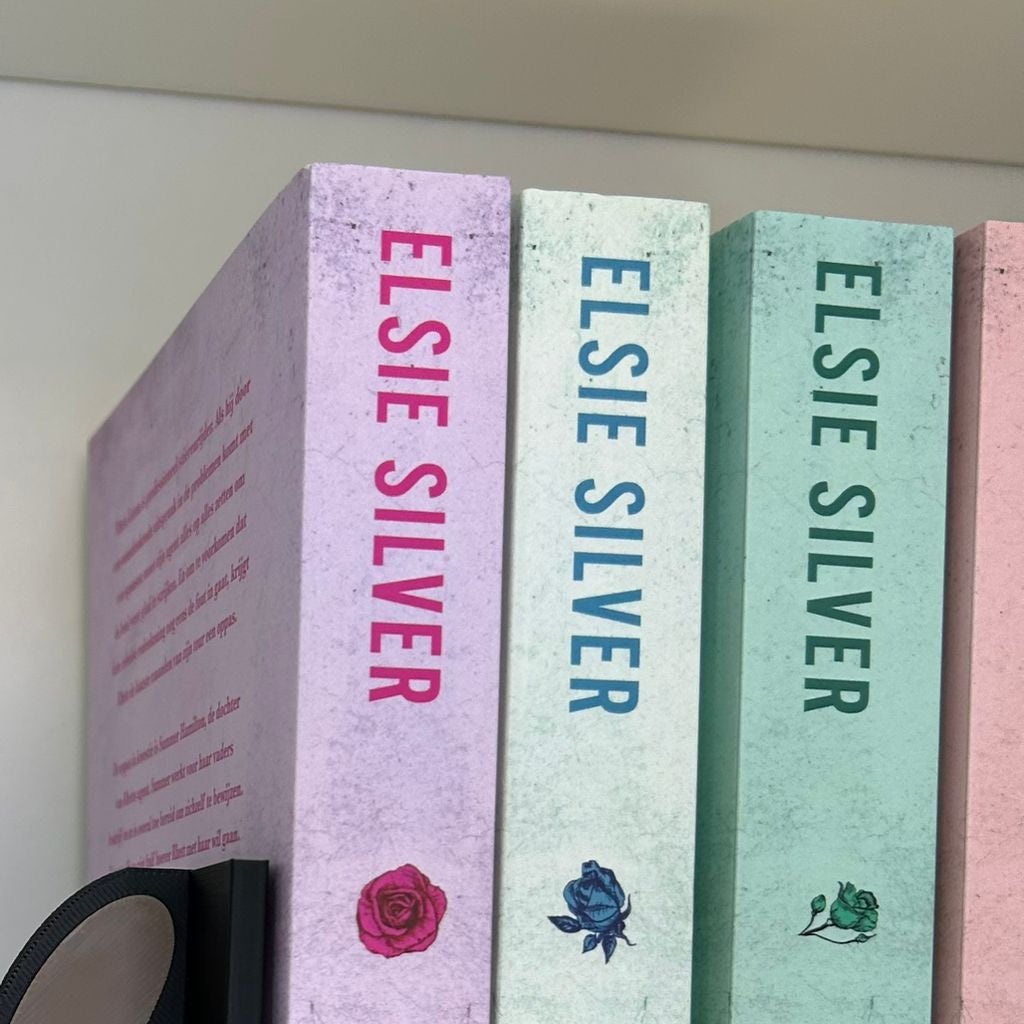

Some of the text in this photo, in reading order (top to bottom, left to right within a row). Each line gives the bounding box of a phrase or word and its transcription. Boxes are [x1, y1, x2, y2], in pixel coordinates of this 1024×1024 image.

[235, 379, 250, 405] door
[222, 434, 238, 462] komt
[239, 419, 253, 444] met
[368, 230, 453, 703] ELSIE SILVER
[234, 473, 245, 492] om
[569, 256, 651, 714] ELSIE SILVER
[804, 261, 884, 714] ELSIE SILVER
[235, 513, 247, 535] dat
[230, 556, 249, 583] krijgt
[207, 706, 214, 724] de
[216, 696, 240, 720] dochter
[198, 753, 210, 770] haar
[212, 742, 234, 763] vaders
[213, 783, 243, 806] bewijzen.
[197, 836, 210, 852] haar
